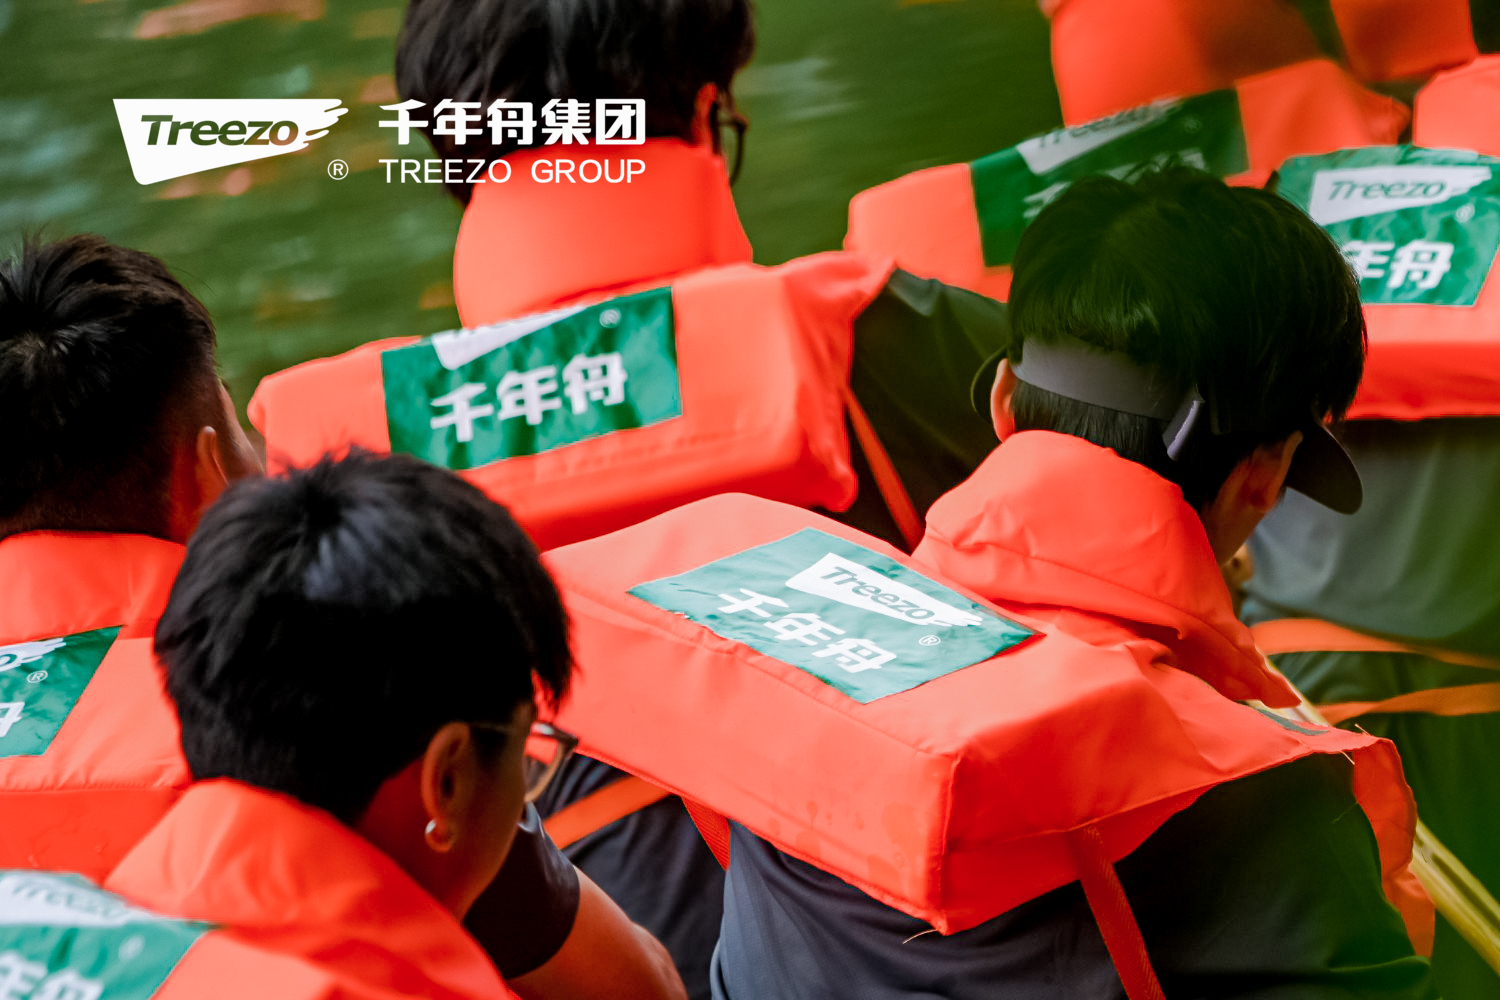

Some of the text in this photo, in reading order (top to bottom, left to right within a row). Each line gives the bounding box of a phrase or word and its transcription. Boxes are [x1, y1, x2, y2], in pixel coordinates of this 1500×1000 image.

[1329, 179, 1447, 201] Treezo
[1338, 238, 1455, 289] 年舟
[429, 352, 627, 442] 千年舟
[821, 566, 936, 621] Treezo
[717, 588, 897, 674] 千年舟
